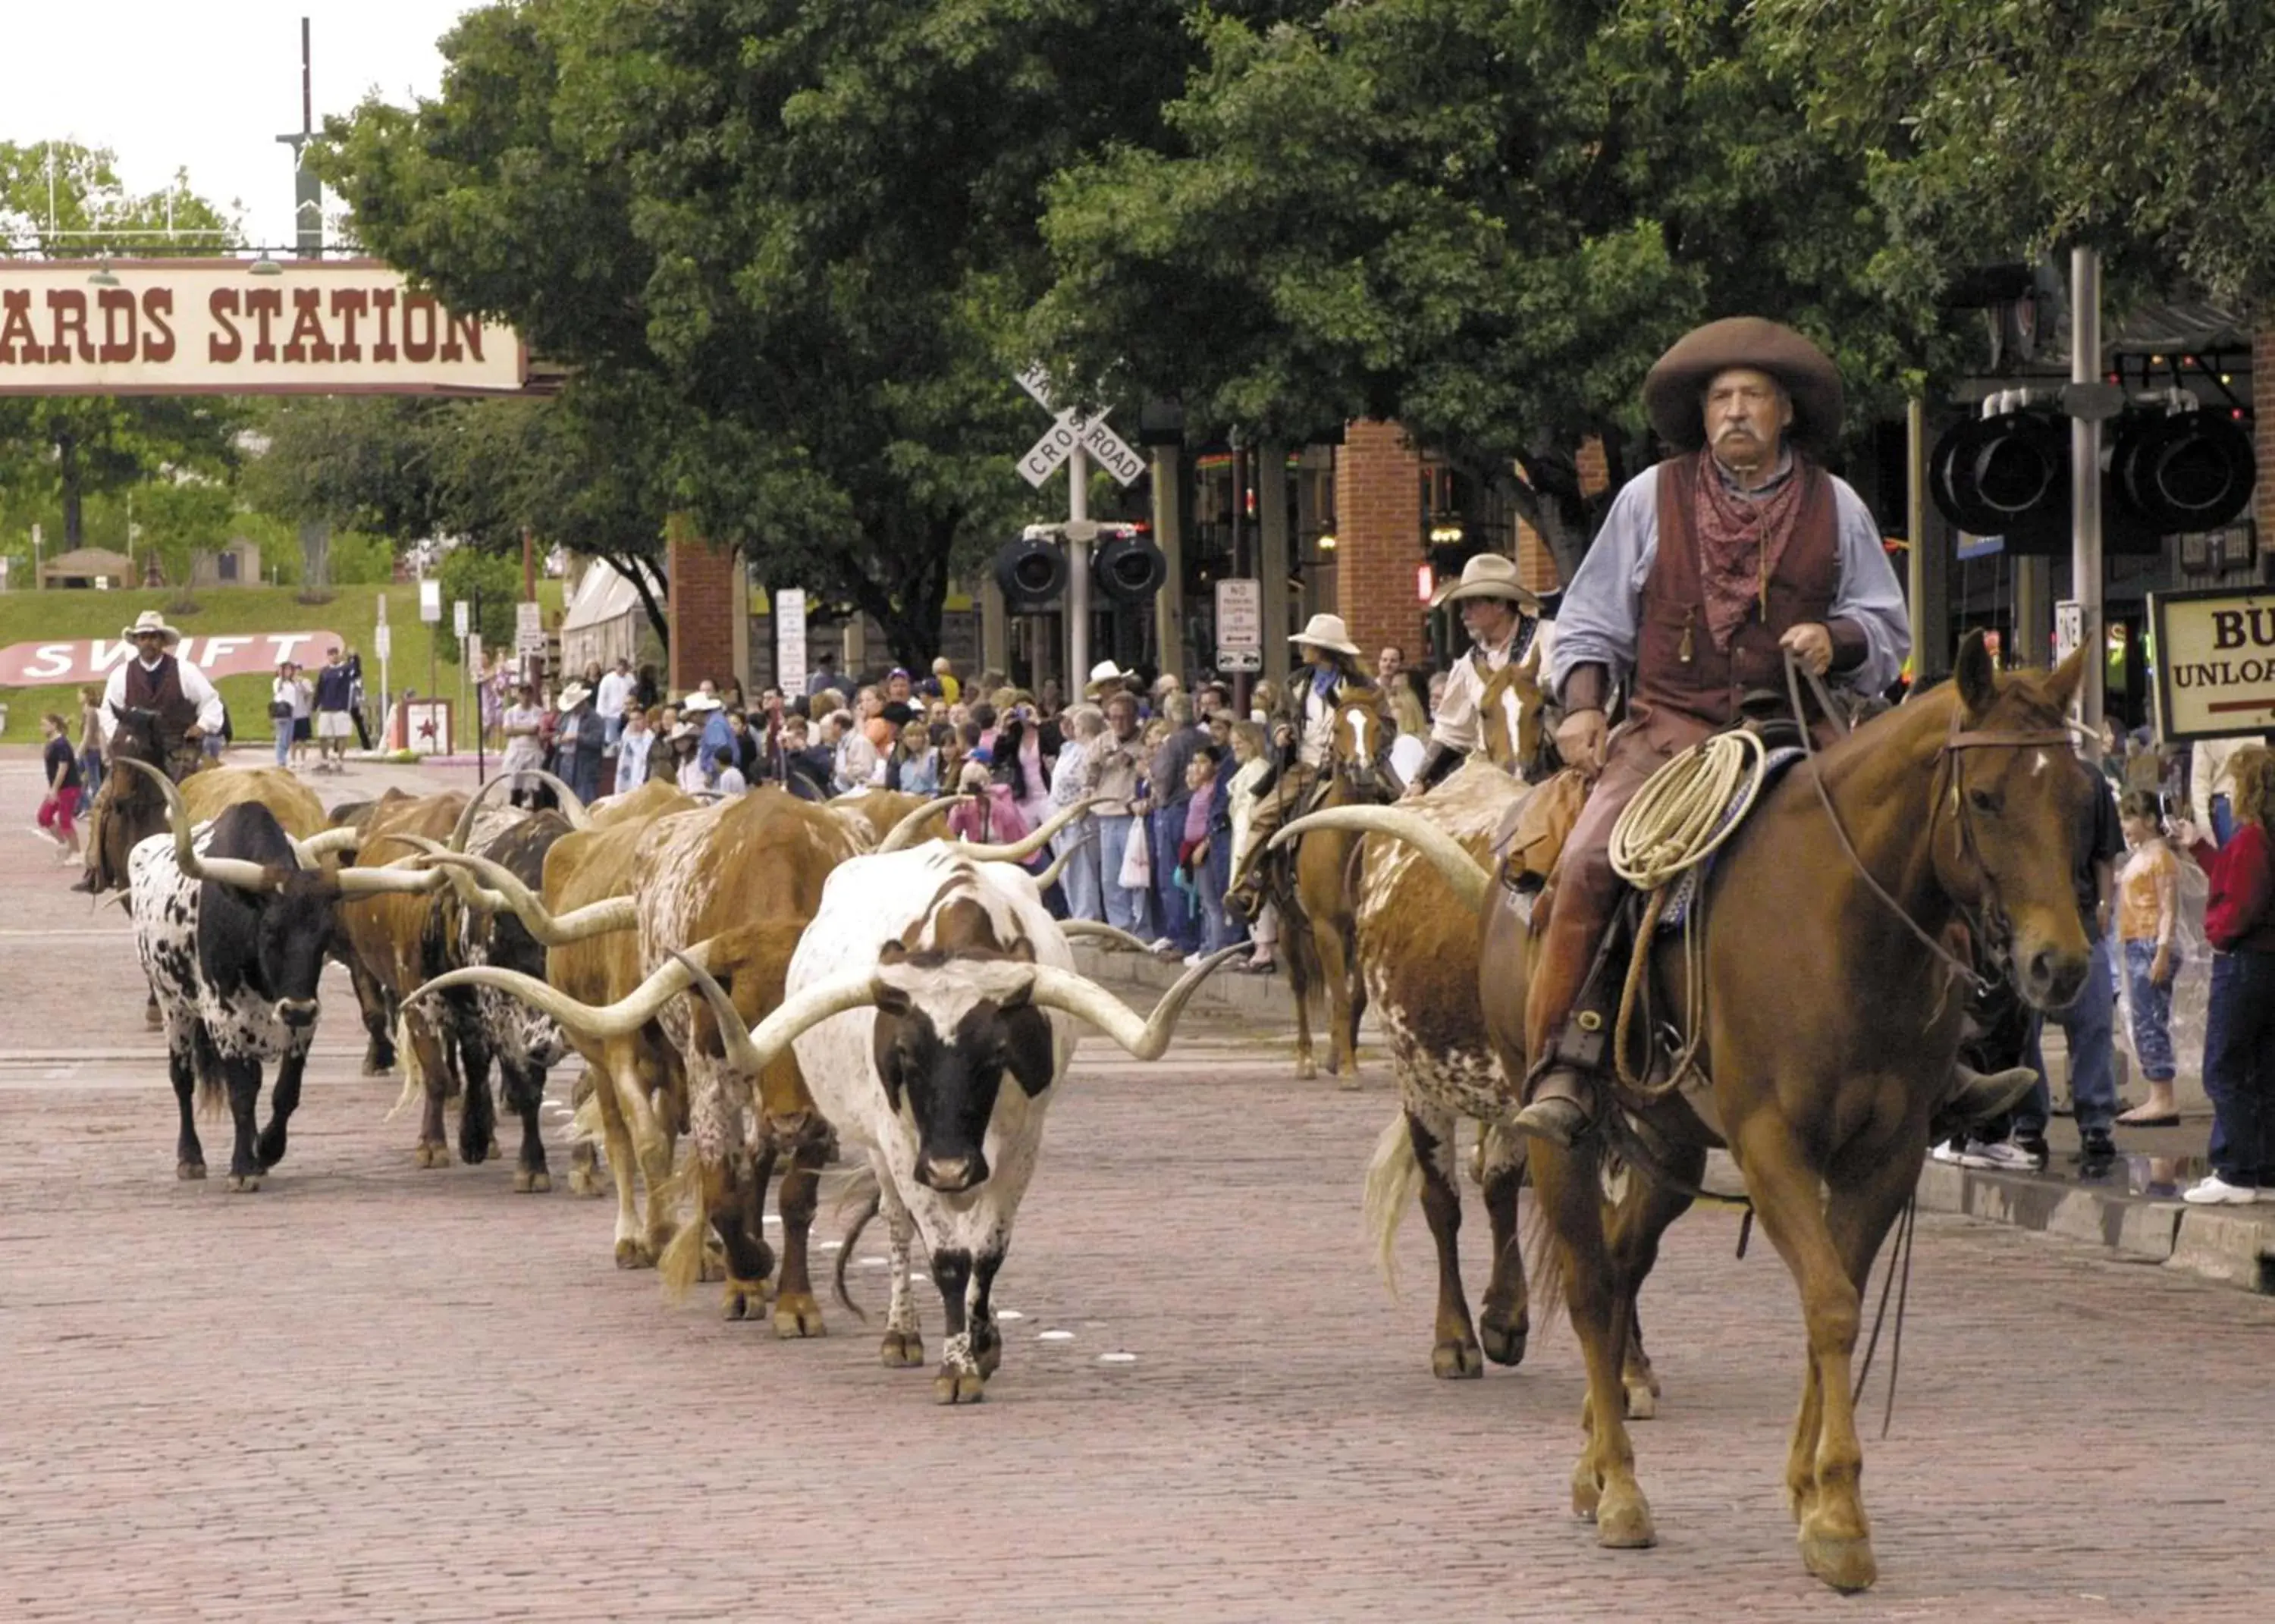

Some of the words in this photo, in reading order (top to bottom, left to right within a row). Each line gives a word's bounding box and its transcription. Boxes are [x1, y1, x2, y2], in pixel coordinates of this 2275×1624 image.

[0, 287, 176, 365] ARDS
[208, 287, 486, 365] STATION
[1024, 365, 1050, 397] RA
[1087, 427, 1138, 478] ROAD
[1028, 415, 1087, 475] CROS
[24, 635, 313, 678] SWIFT
[2211, 608, 2275, 650] BU
